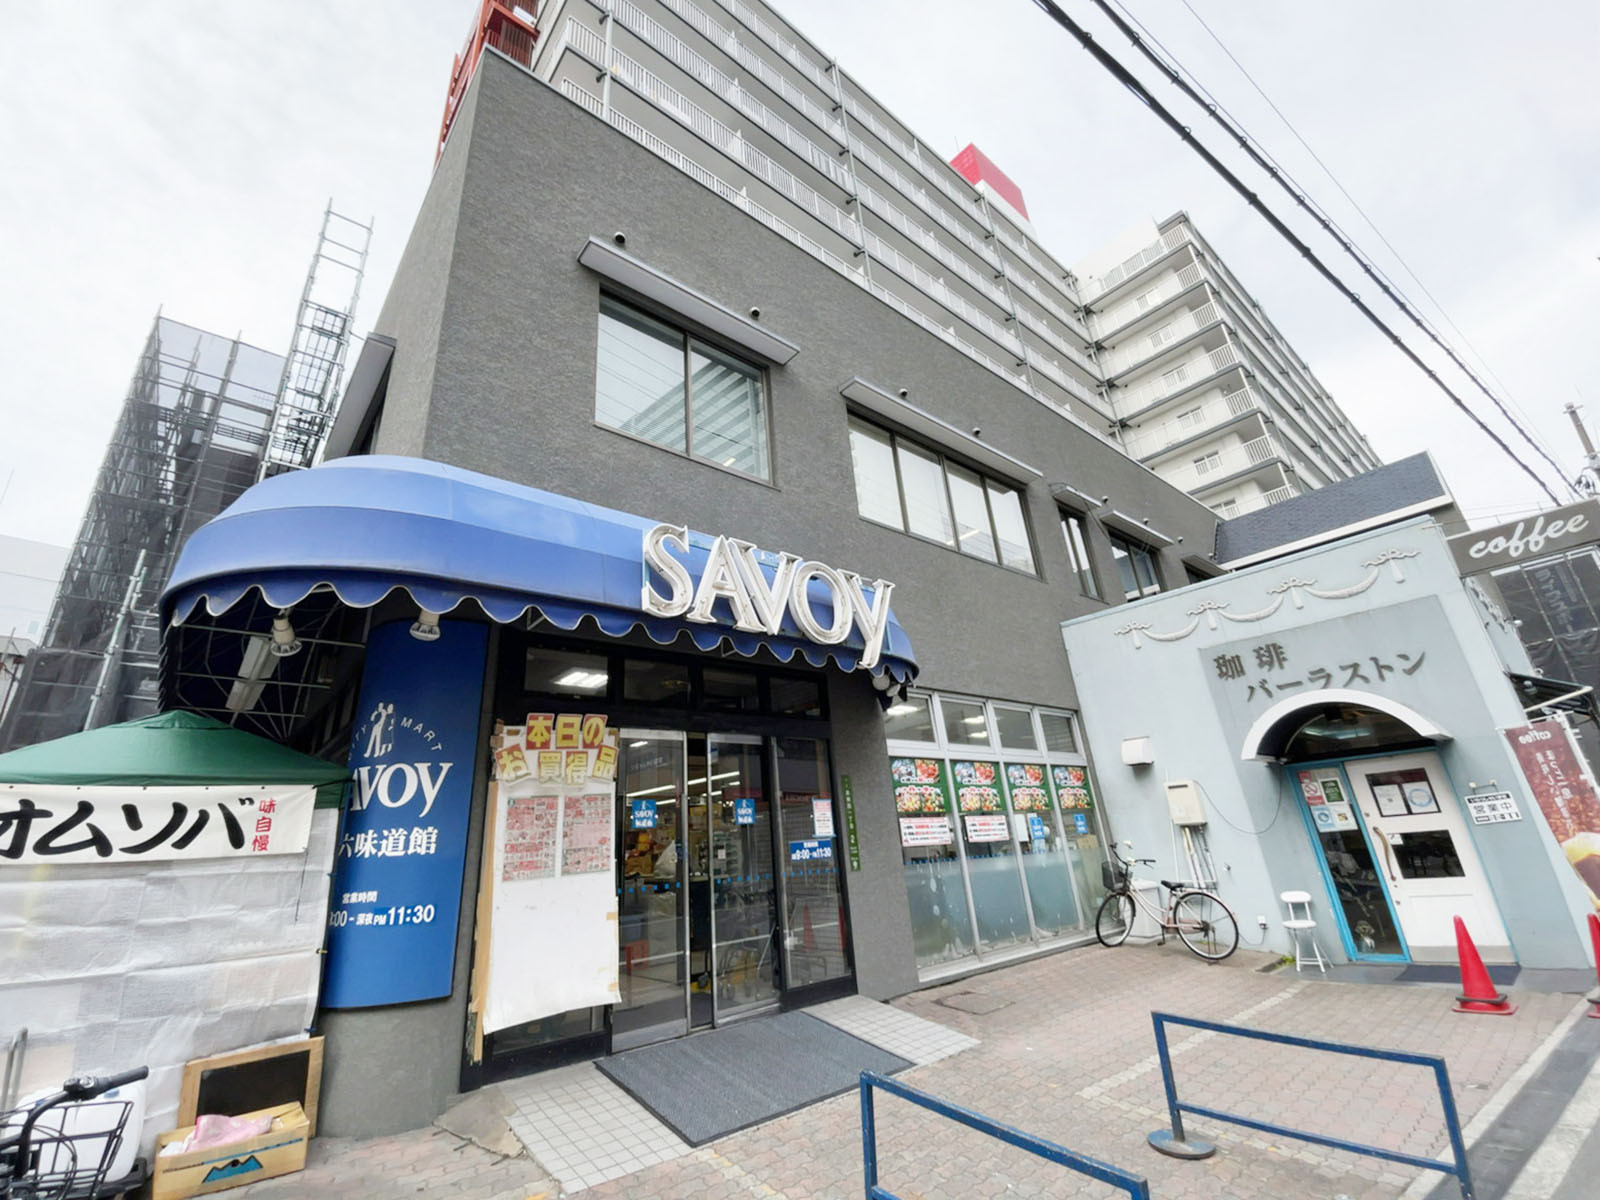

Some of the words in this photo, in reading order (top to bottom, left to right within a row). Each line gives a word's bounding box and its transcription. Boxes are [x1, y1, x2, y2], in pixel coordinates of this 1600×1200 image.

[1468, 514, 1590, 559] coffee
[641, 523, 896, 669] SAVOY
[1212, 642, 1289, 681] 珈琲
[1246, 650, 1427, 702] バーラストン
[400, 716, 443, 752] MART
[527, 715, 606, 748] 本日の
[499, 746, 618, 785] お買得品
[0, 797, 256, 859] オムソバ
[251, 797, 276, 853] 味自慢
[338, 825, 439, 859] 六味道館
[342, 890, 378, 904] 営業時間
